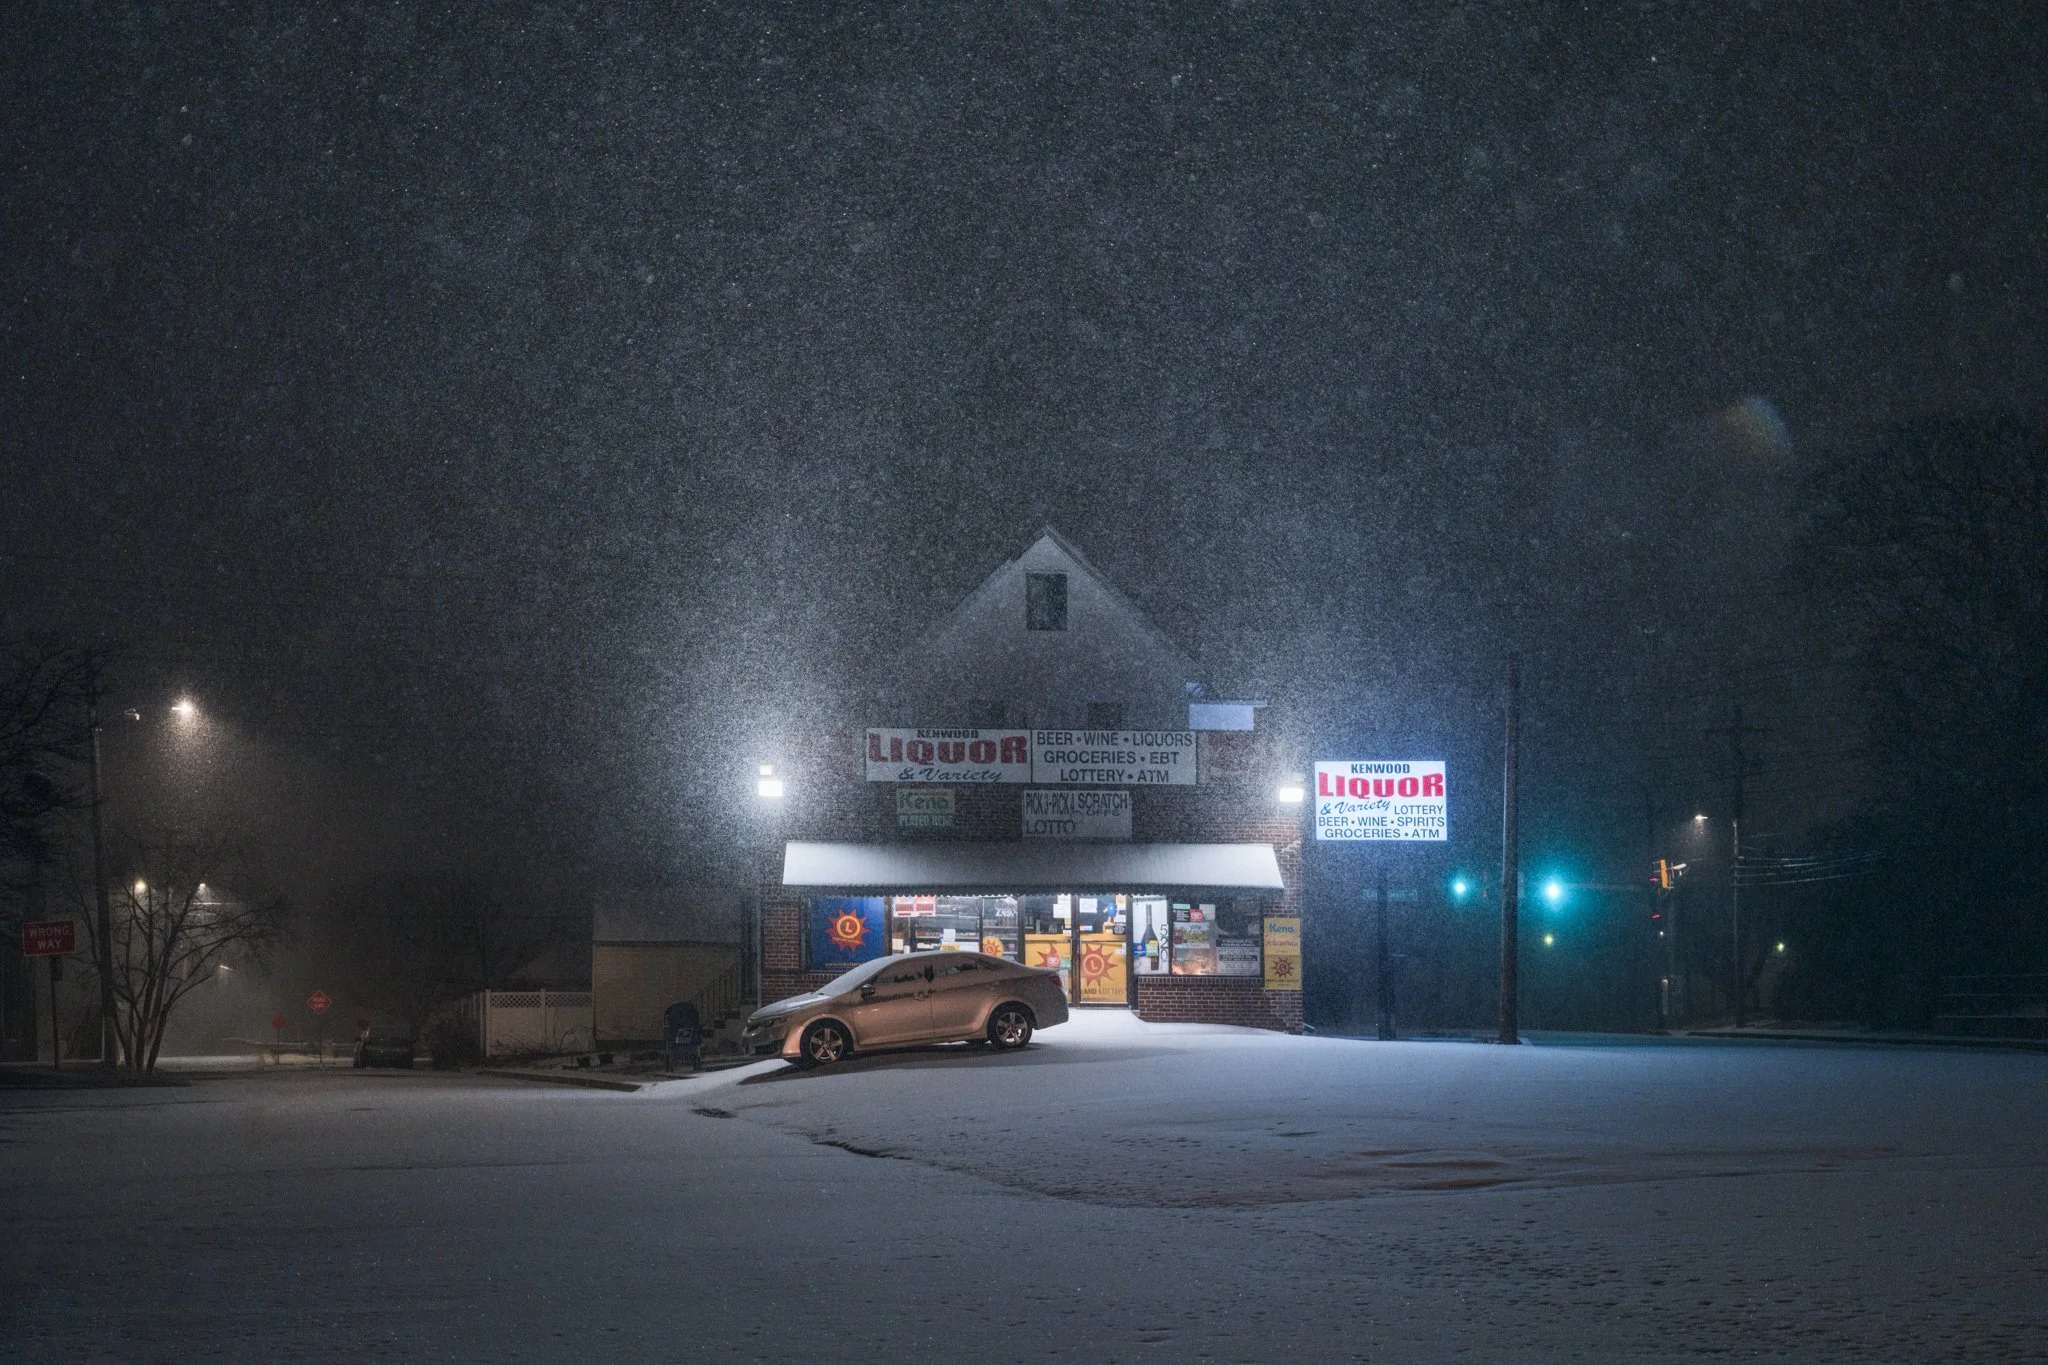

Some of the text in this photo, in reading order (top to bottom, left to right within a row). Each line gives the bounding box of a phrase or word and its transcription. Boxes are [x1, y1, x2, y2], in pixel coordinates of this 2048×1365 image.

[916, 729, 979, 739] KENWOOD
[1036, 731, 1194, 748] BEER WINE LIQUORS
[868, 732, 1028, 766] LIQUOR
[1044, 750, 1180, 765] GROCERIES EBT
[918, 767, 1003, 784] Variety
[1059, 768, 1170, 783] LOTTERY ATM
[1350, 763, 1411, 774] KENWOOD
[1318, 771, 1444, 800] LIQUOR
[1077, 792, 1128, 809] SCRATCH
[1320, 798, 1392, 816] & Variety
[1393, 804, 1444, 815] LOTTERY
[1025, 819, 1076, 835] LOTTO
[1318, 816, 1445, 827] BEER WINE SPIRITS
[1324, 828, 1440, 838] GROCERIES ATM
[28, 925, 71, 939] WRONG
[37, 939, 62, 950] WAY
